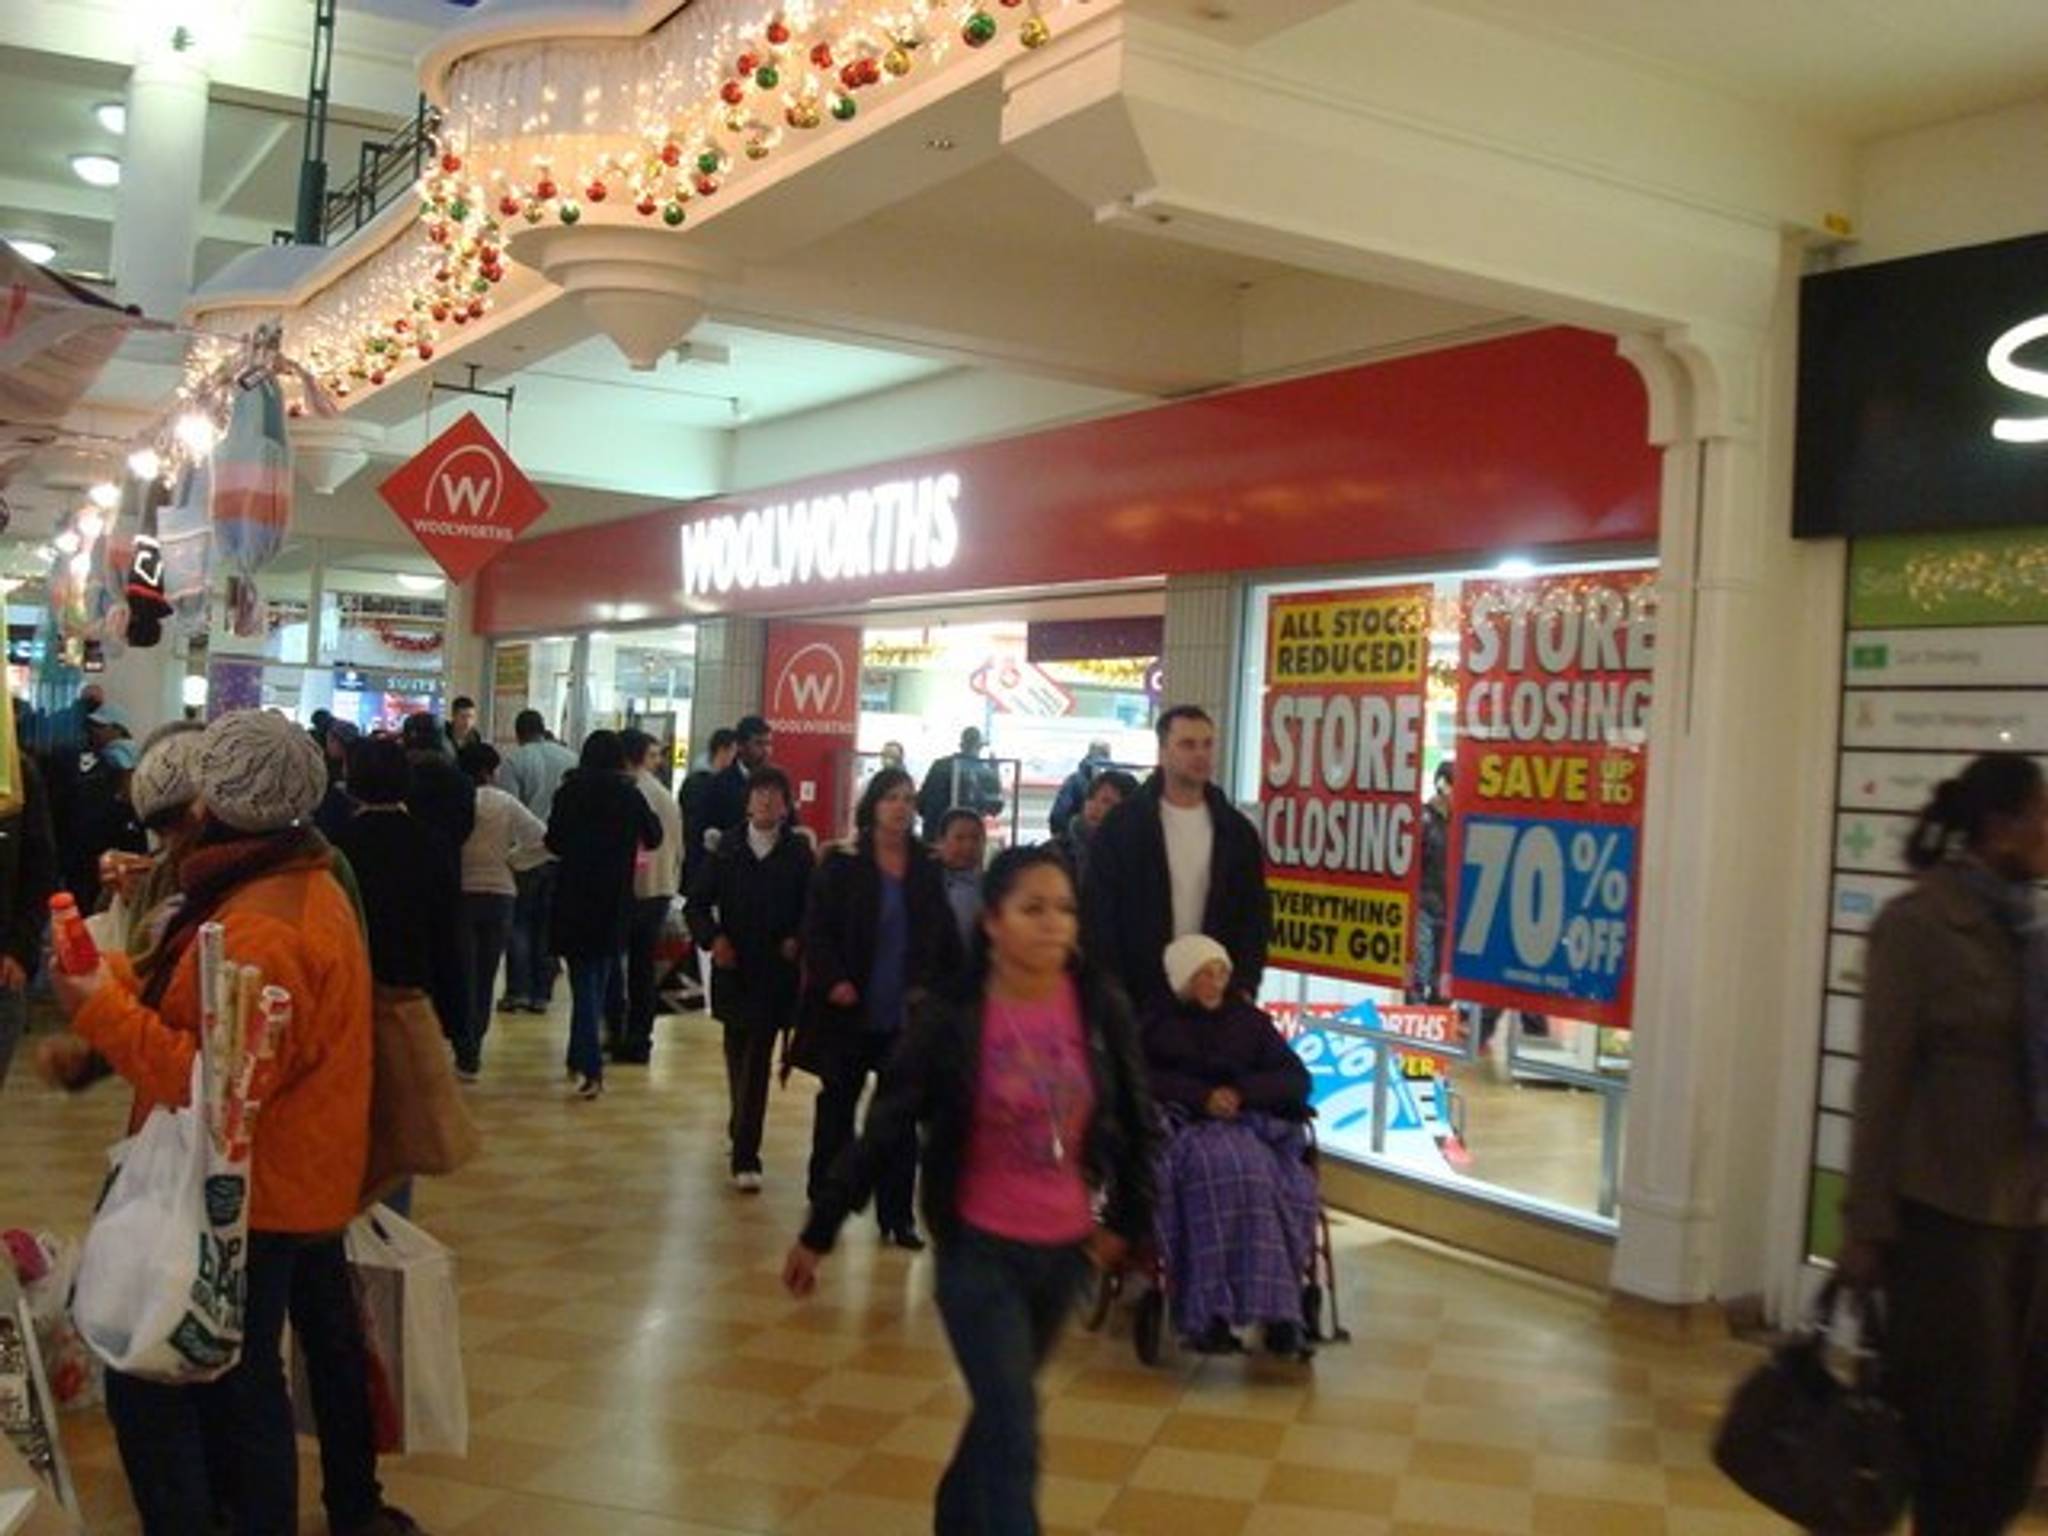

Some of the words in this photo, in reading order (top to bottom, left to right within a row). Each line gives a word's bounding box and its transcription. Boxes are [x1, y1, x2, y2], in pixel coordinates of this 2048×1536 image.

[441, 473, 491, 517] W
[413, 518, 513, 541] WOOLWORTHS
[682, 472, 960, 595] WOOLWORTHS
[1280, 611, 1323, 640] ALL
[1467, 584, 1656, 674] STORE
[1278, 640, 1417, 675] REDUCED!
[1465, 680, 1651, 744] CLOSING
[1267, 694, 1420, 793] STORE
[1477, 754, 1589, 802] SAVE
[1599, 759, 1635, 780] UP
[1601, 783, 1634, 805] TO
[1265, 797, 1415, 877] CLOSING
[1269, 888, 1403, 927] VERYTHING
[1347, 927, 1402, 964] GO!
[1566, 915, 1627, 974] OFF
